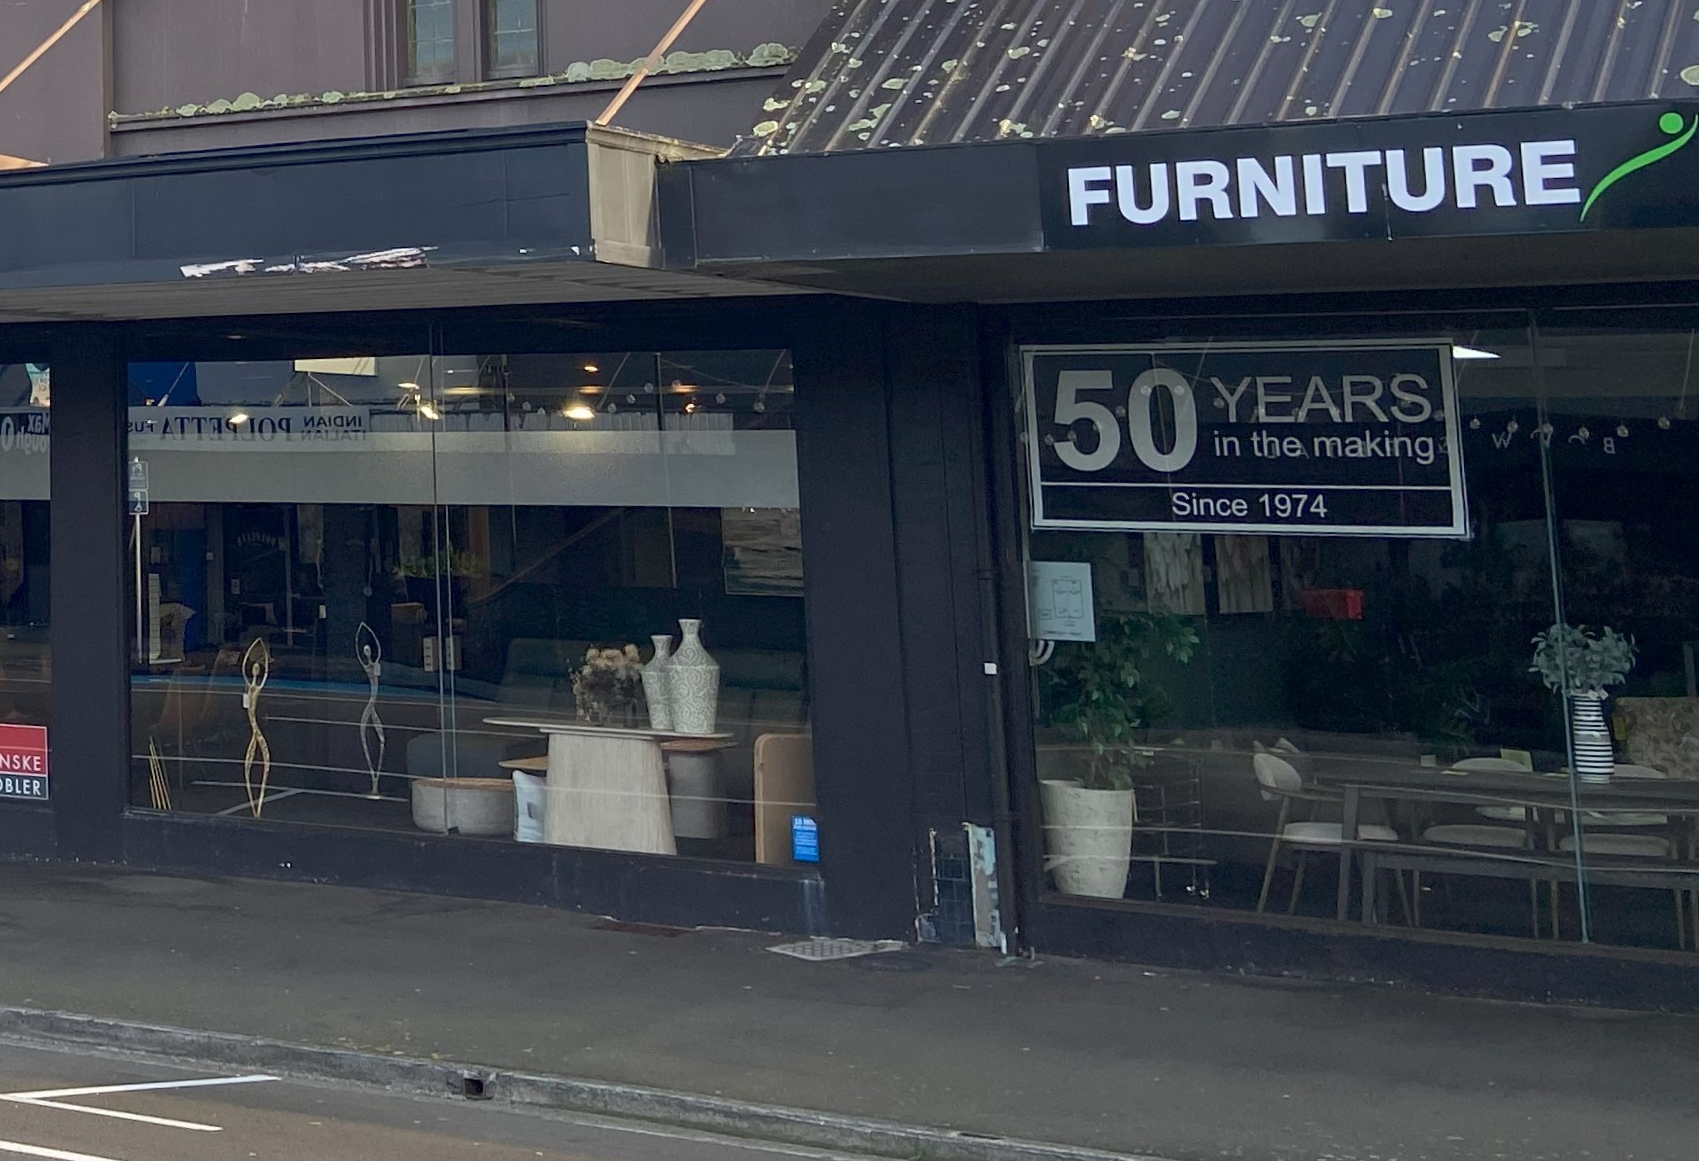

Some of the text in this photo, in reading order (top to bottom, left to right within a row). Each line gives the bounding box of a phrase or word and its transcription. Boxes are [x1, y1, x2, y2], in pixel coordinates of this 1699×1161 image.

[1067, 140, 1581, 226] FURNITURE
[1054, 368, 1432, 472] 50 YEARS
[1214, 430, 1434, 464] in the making
[1172, 492, 1327, 518] Since 1974
